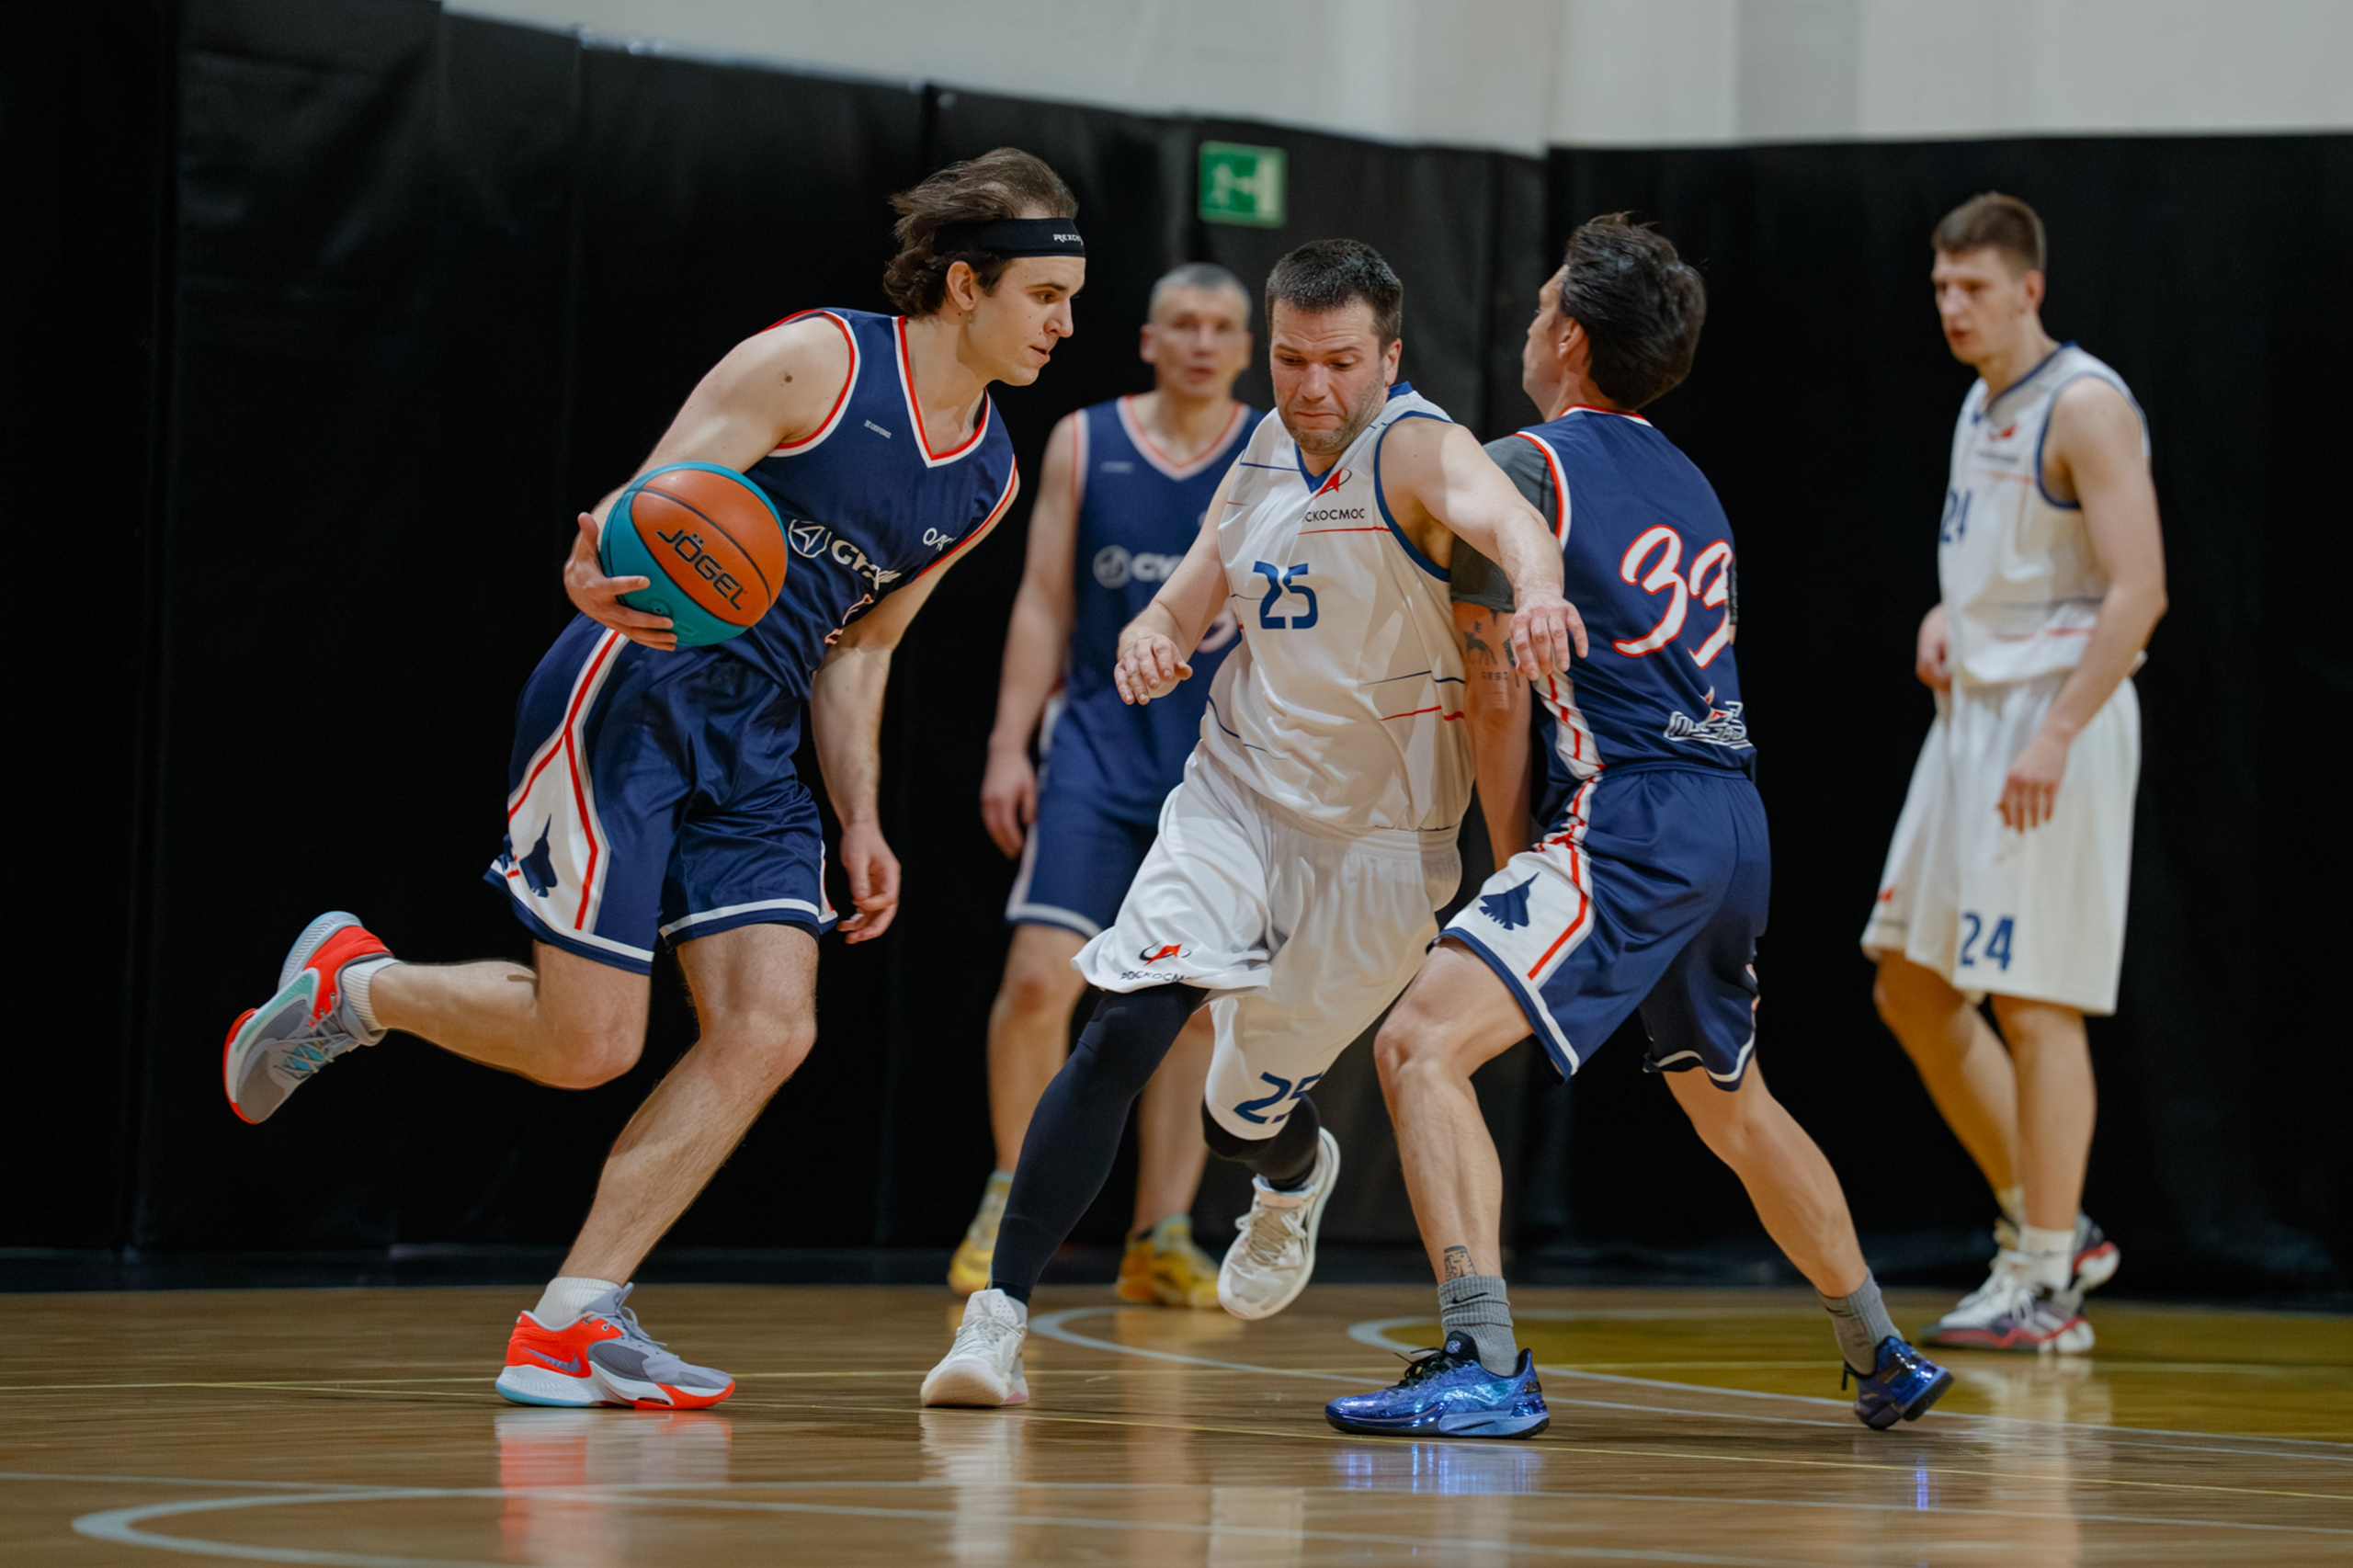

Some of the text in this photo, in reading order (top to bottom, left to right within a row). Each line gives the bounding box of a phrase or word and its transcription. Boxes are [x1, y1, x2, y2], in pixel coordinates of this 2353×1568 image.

[1302, 507, 1365, 523] СКОСМОС
[655, 528, 744, 611] JÖGEL
[1253, 560, 1318, 630] 25
[1960, 913, 2015, 971] 24
